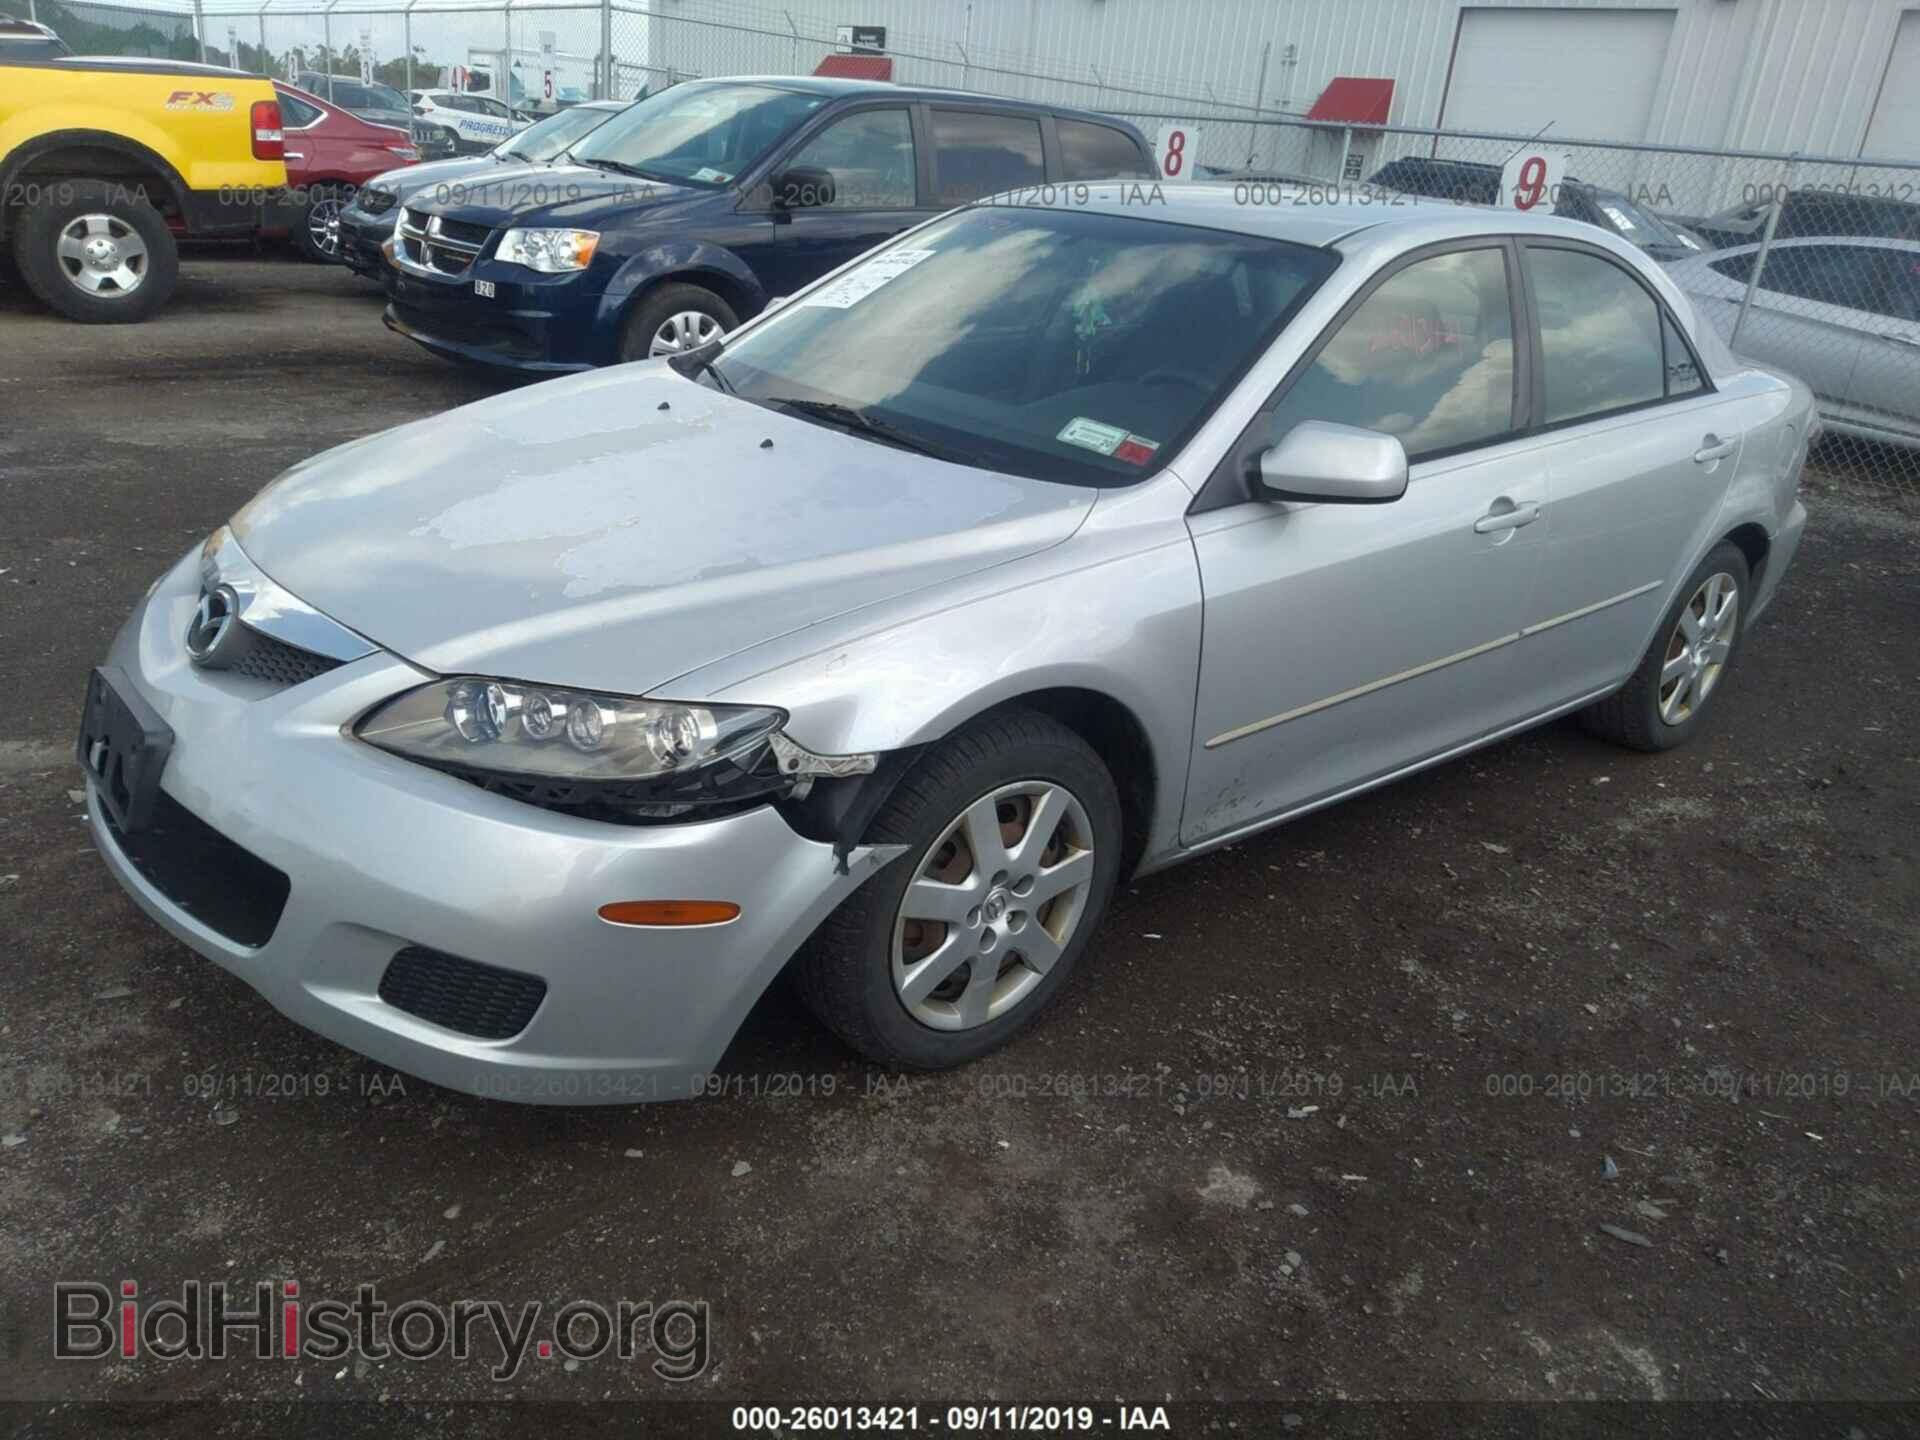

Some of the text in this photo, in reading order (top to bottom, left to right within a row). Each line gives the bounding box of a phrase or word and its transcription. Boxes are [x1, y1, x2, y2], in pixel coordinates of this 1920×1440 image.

[544, 70, 553, 98] 5
[1163, 130, 1186, 177] 8
[1514, 156, 1547, 211] 9
